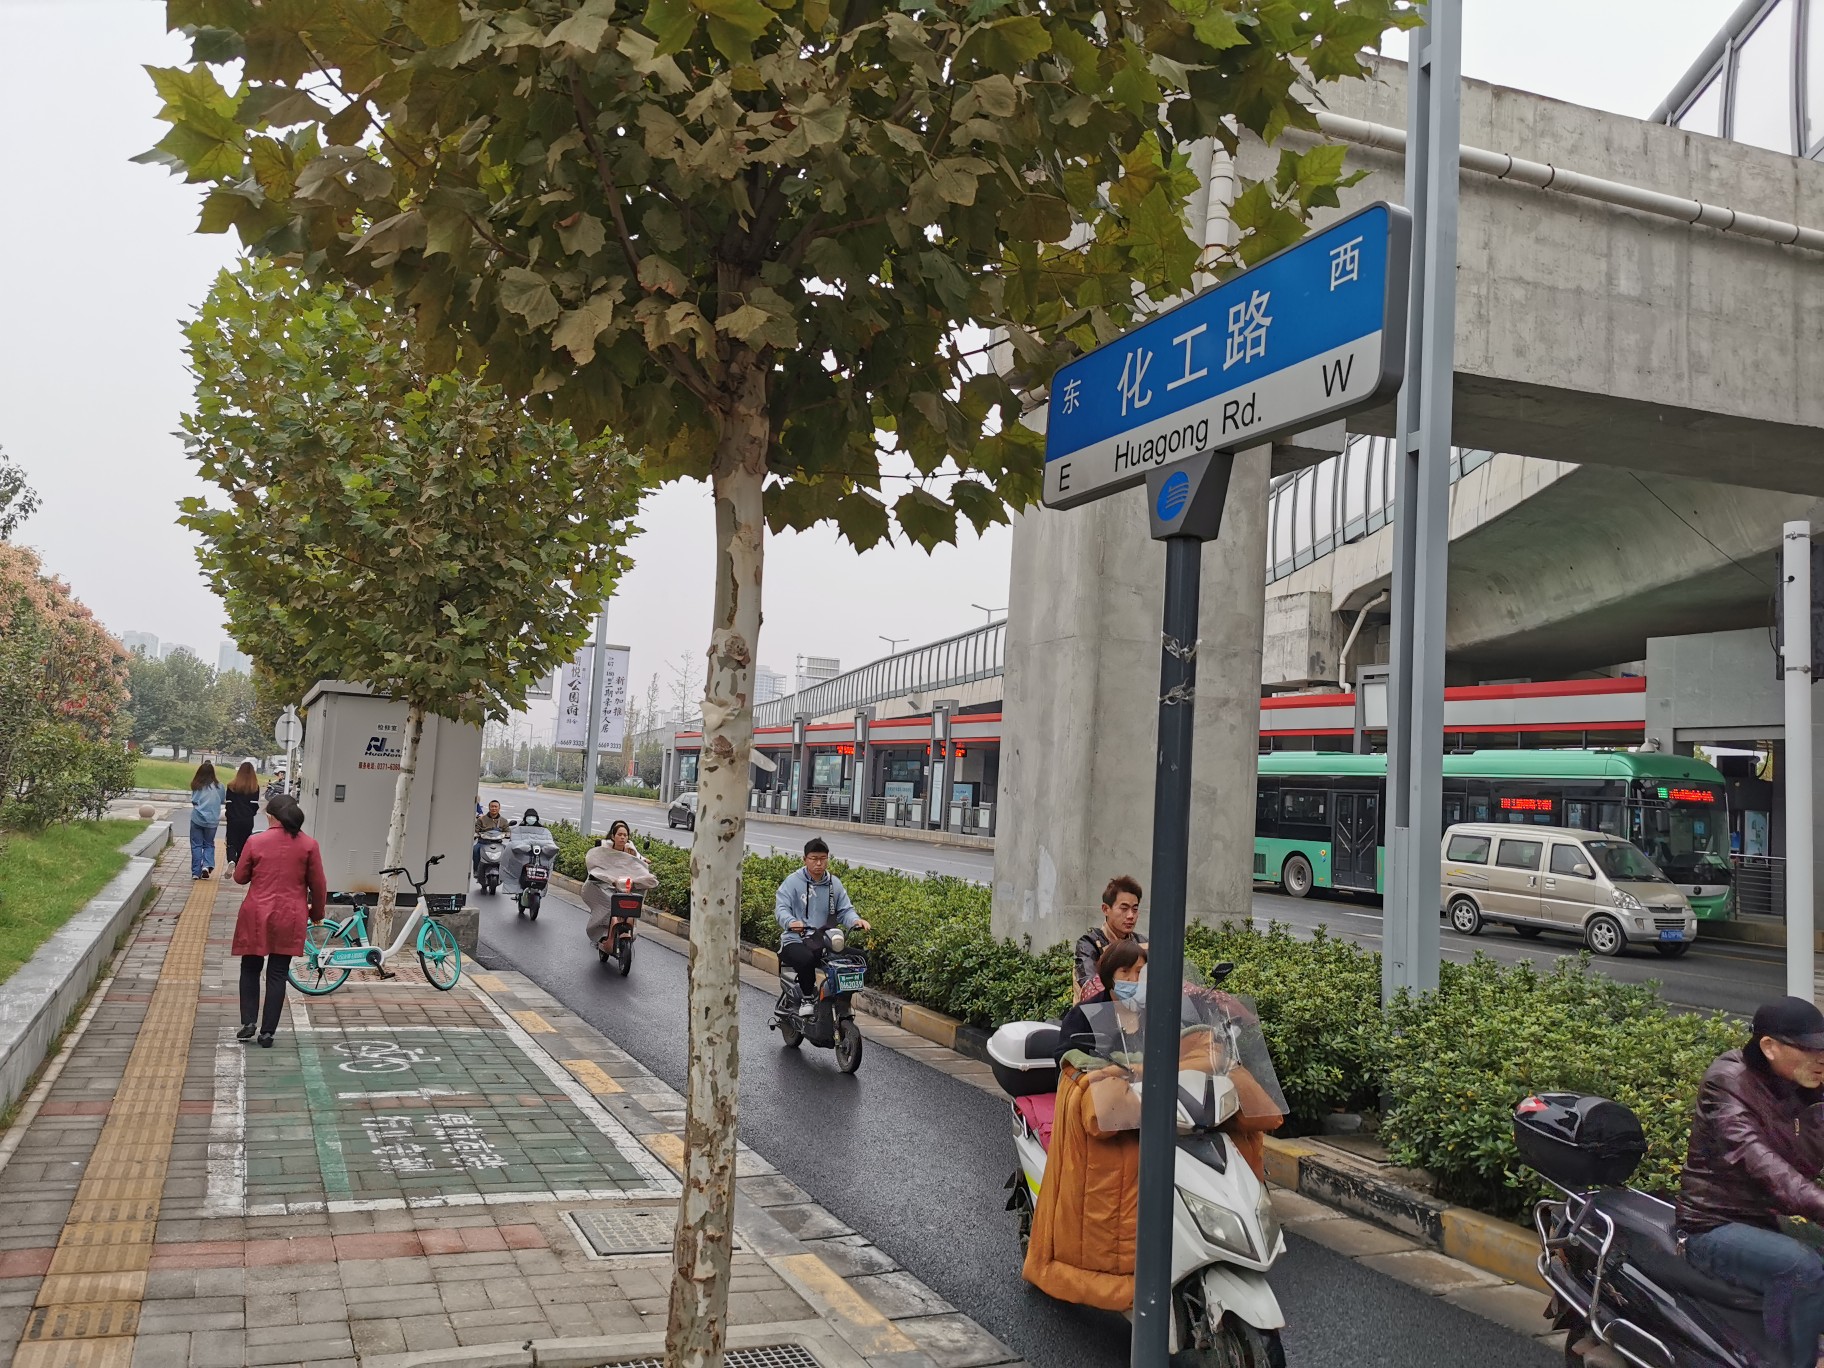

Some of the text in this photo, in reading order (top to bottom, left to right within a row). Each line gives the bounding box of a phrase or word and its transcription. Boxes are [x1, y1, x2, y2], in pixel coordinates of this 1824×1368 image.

[1061, 234, 1364, 416] 东 化工路 西
[1058, 353, 1355, 492] E Huagong Rd. W
